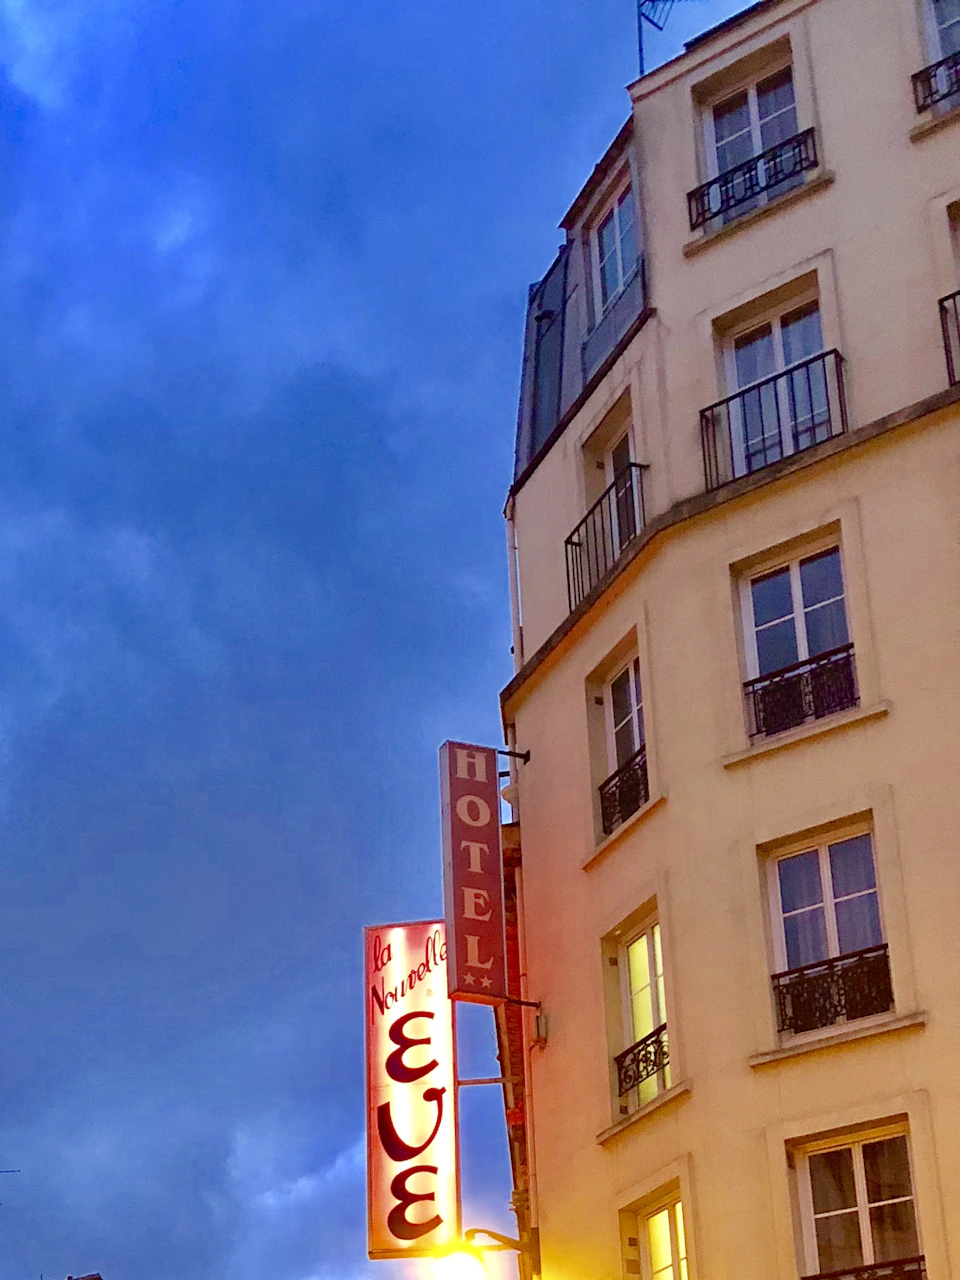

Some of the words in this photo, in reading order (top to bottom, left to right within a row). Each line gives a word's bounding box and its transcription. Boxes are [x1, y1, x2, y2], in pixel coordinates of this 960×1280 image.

[455, 748, 494, 973] HOTEL
[370, 930, 448, 1023] Nouvelle
[376, 1010, 446, 1242] EVE
